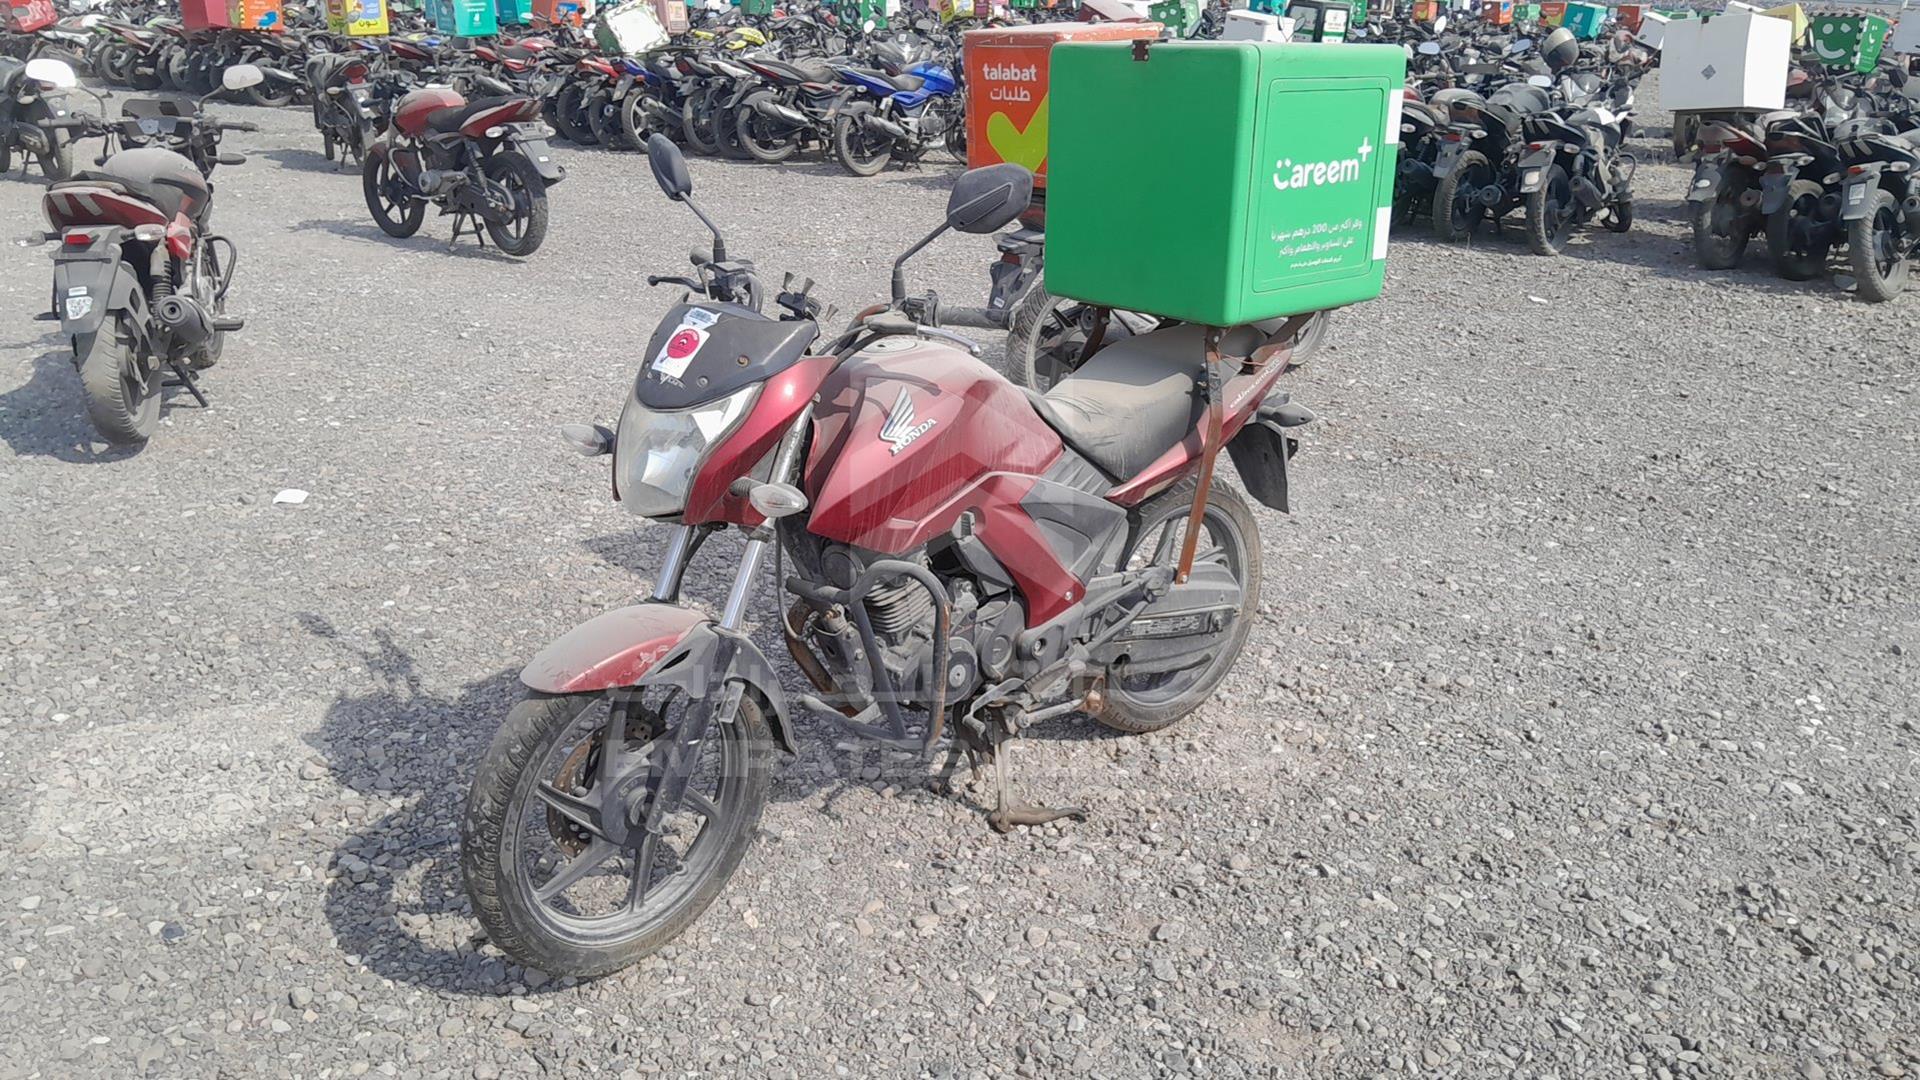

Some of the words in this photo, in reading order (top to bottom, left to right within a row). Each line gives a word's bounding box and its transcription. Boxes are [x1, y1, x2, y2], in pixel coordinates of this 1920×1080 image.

[982, 62, 1038, 82] talabat
[990, 84, 1031, 106] طلبات
[1312, 222, 1328, 234] 200
[888, 418, 937, 456] HONDA
